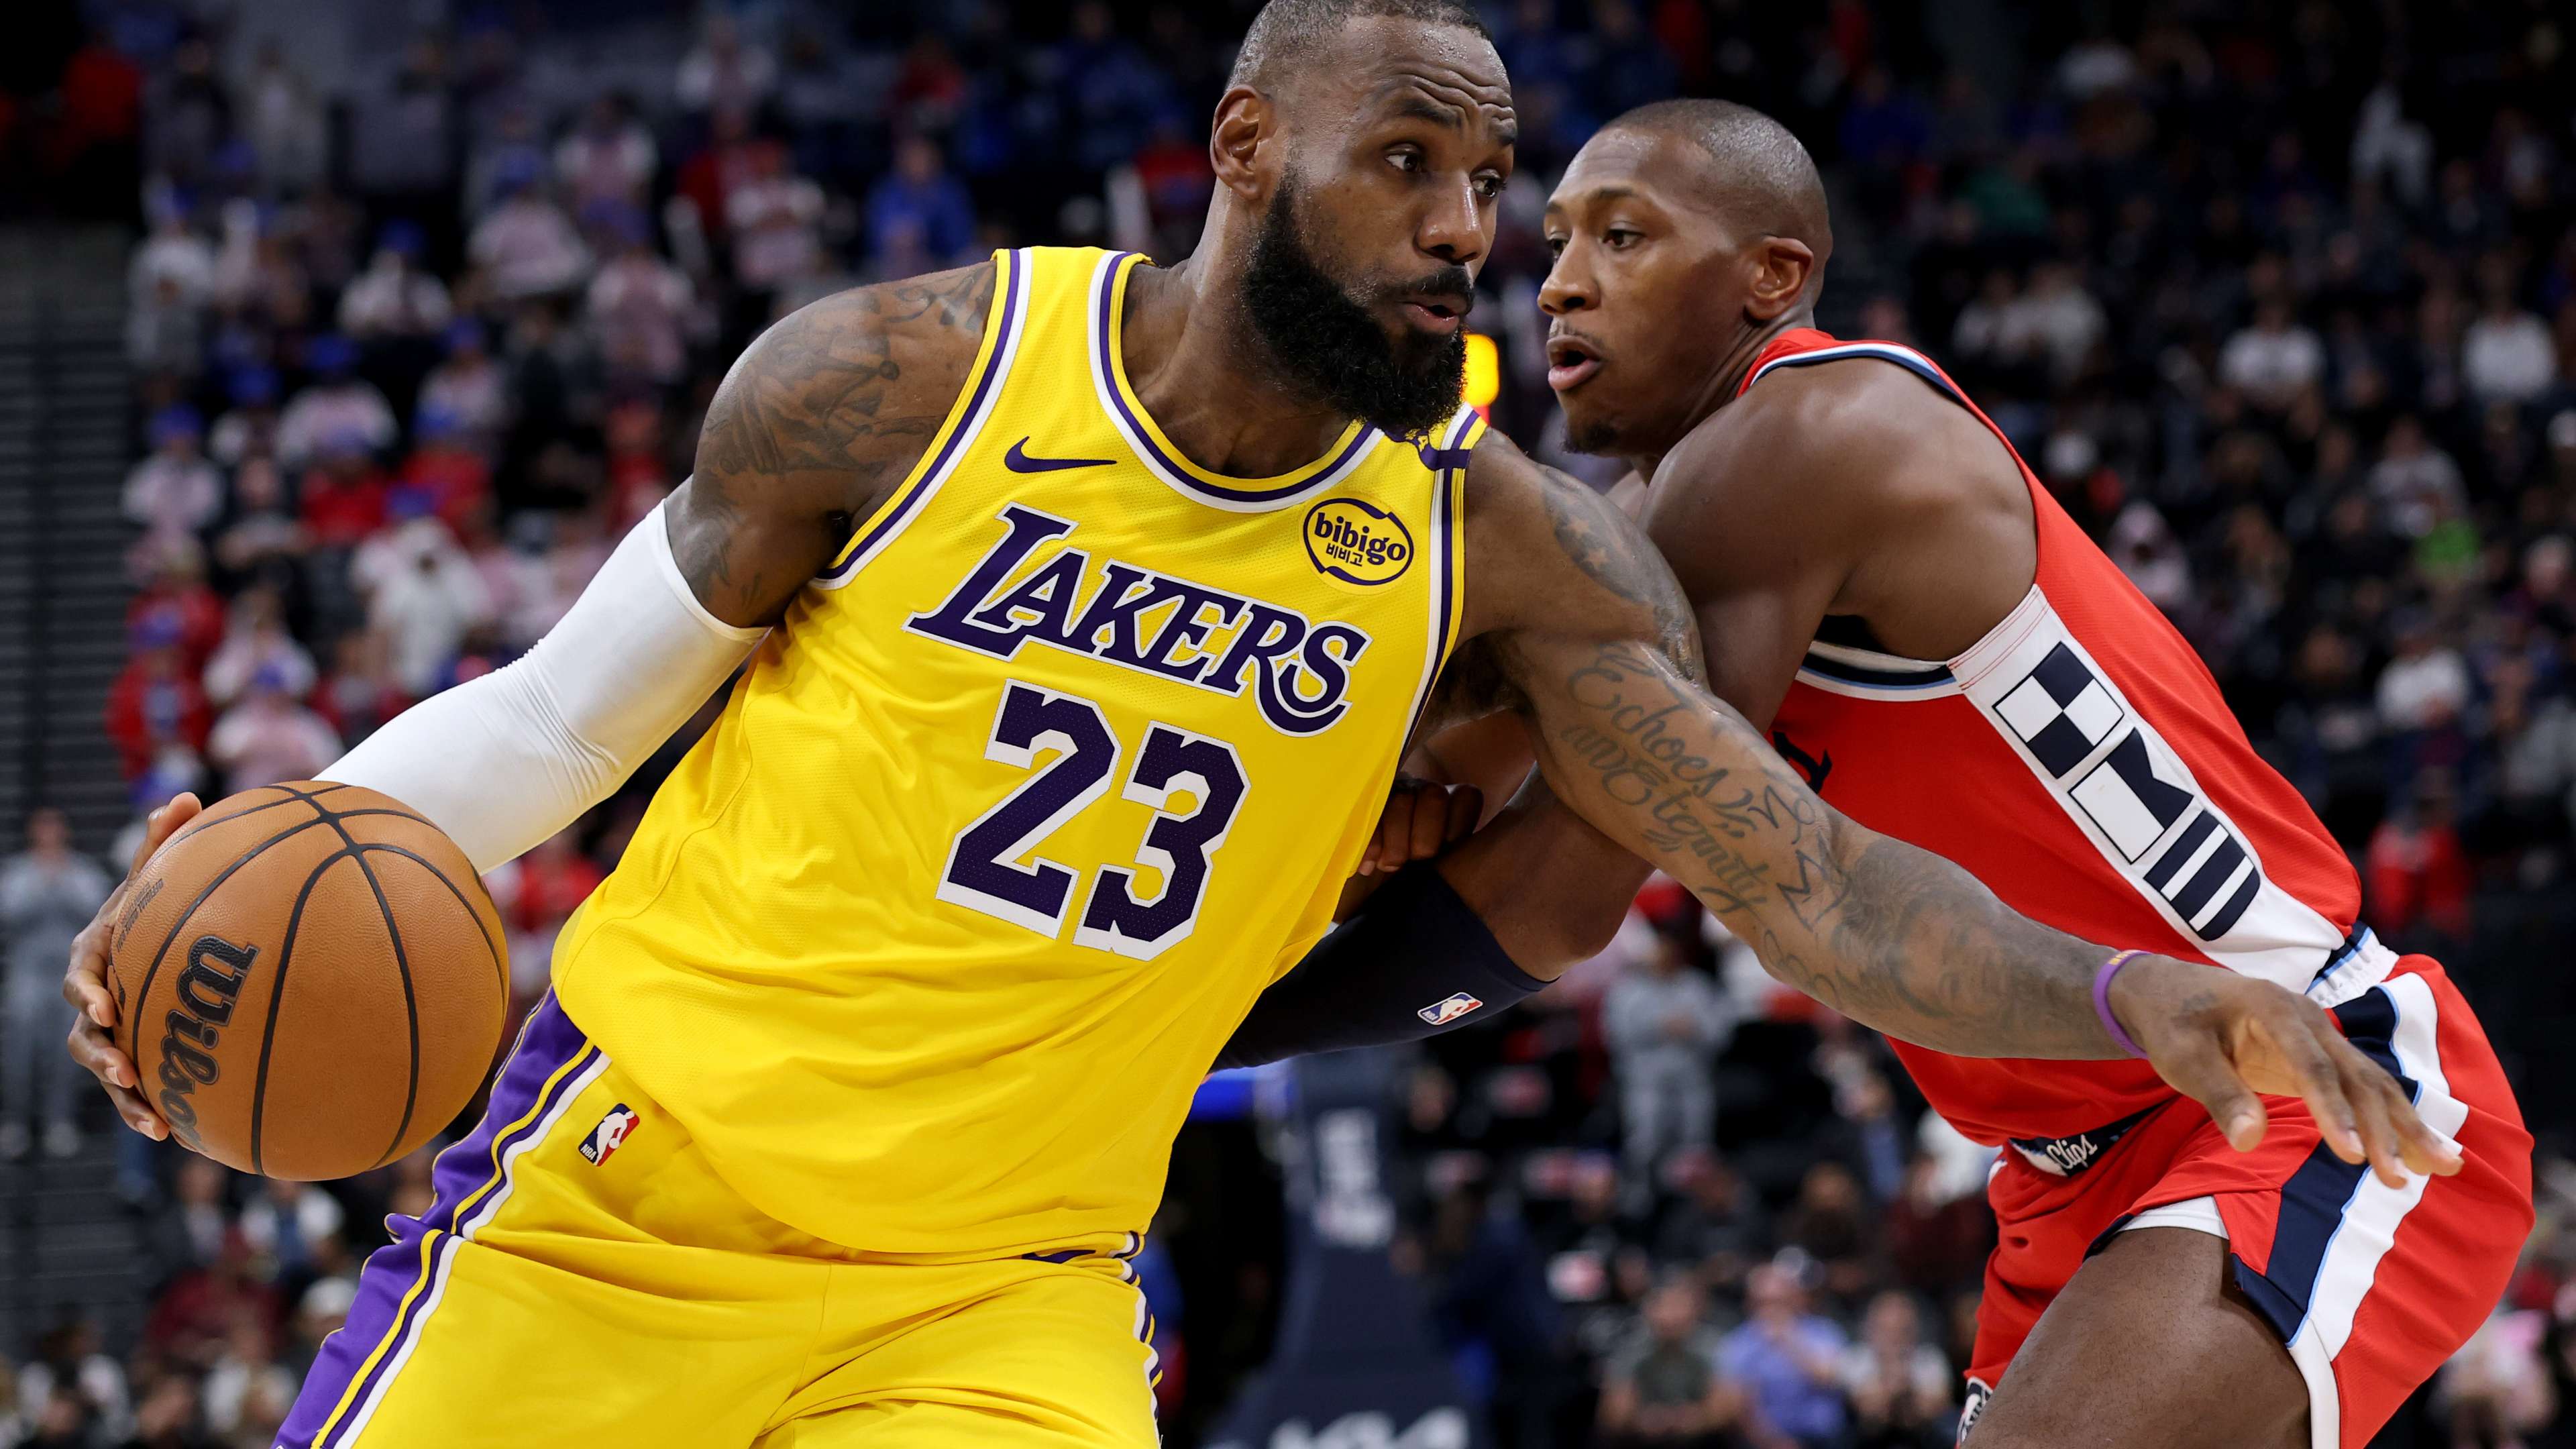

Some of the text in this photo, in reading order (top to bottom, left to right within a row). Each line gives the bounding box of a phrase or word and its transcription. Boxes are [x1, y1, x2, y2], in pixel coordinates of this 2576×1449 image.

[1314, 512, 1406, 565] bibigo
[1326, 543, 1363, 567] 비비고
[903, 502, 1372, 737] LAKERS
[935, 678, 1252, 961] 23
[580, 1143, 597, 1161] NBA
[2047, 1134, 2098, 1169] Clips
